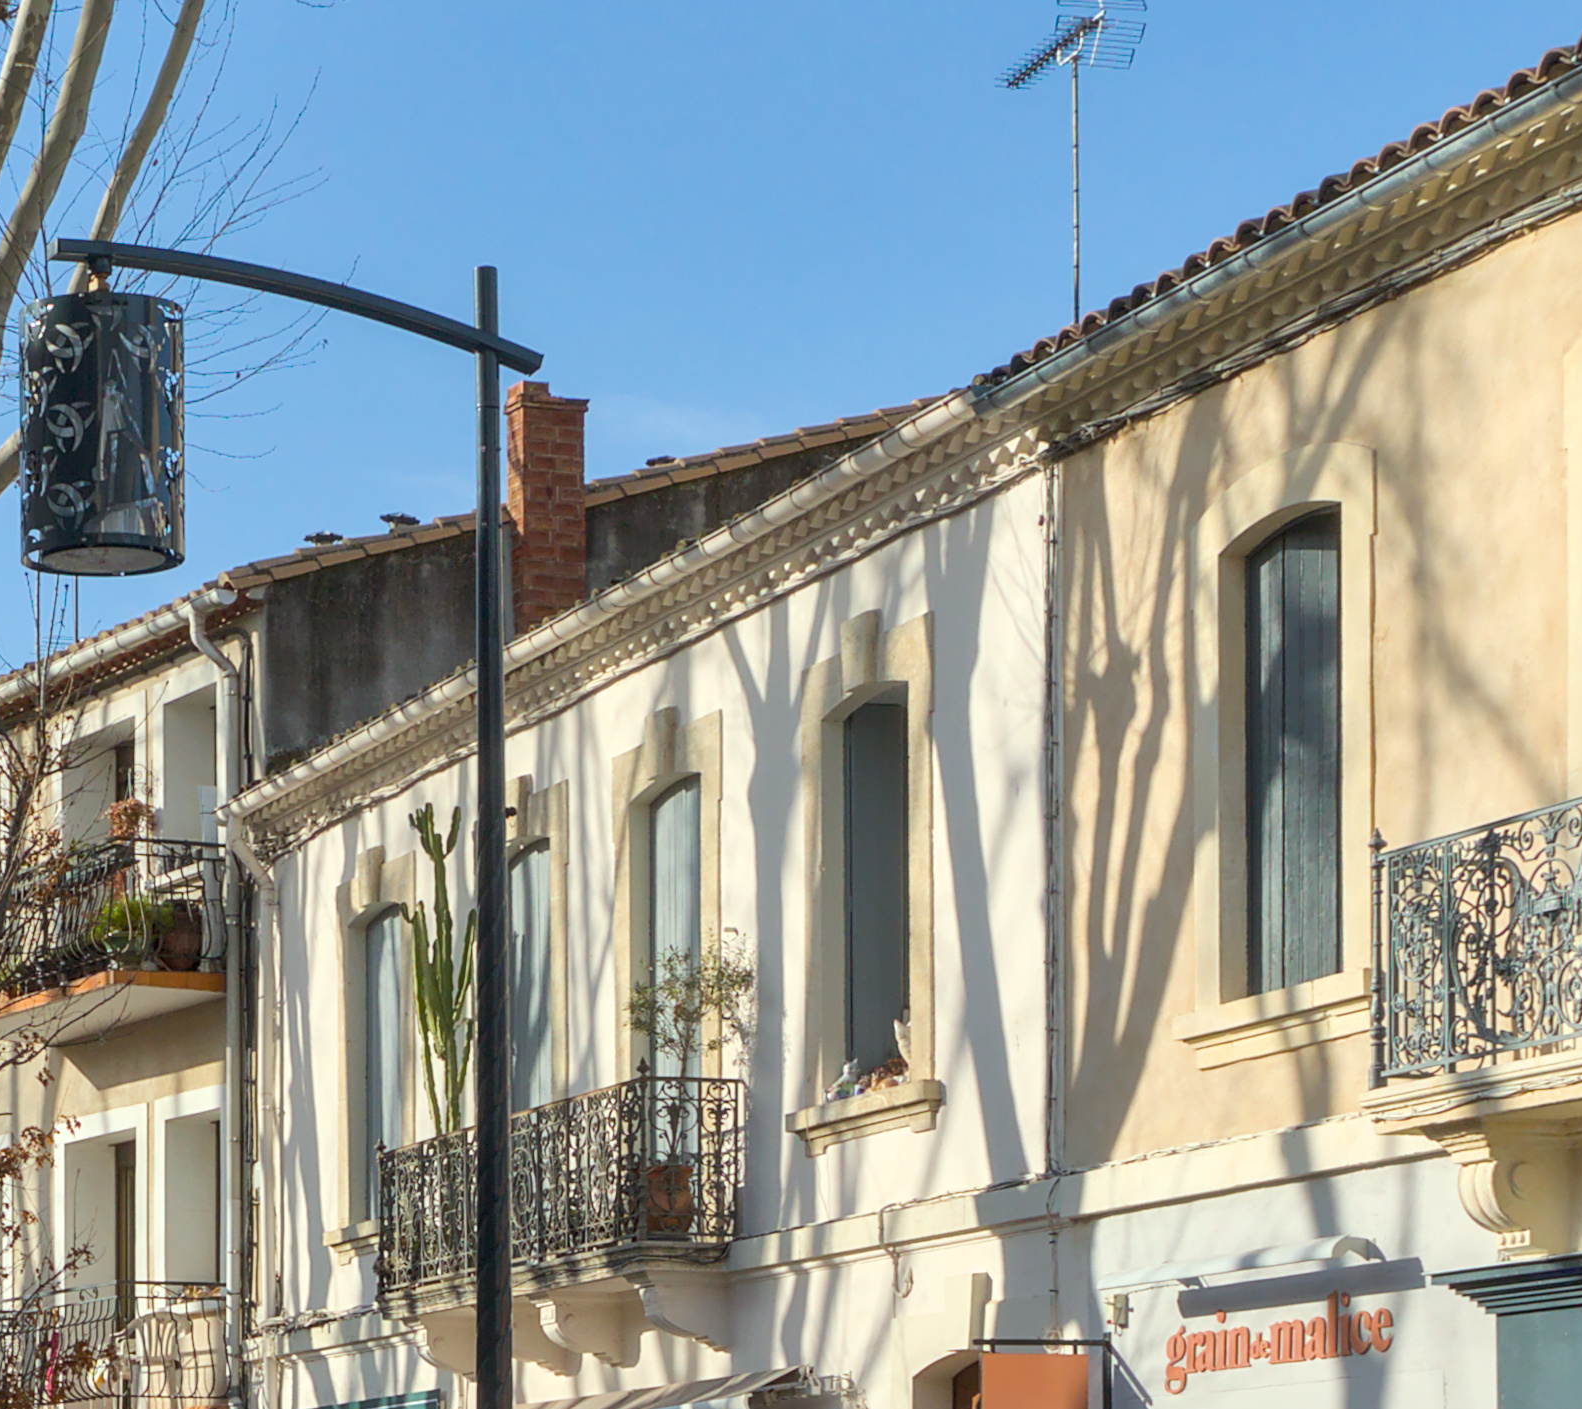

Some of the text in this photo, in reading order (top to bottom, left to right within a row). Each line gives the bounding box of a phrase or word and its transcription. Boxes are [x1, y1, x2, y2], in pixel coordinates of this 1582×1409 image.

[1164, 1290, 1394, 1394] grain de malice
